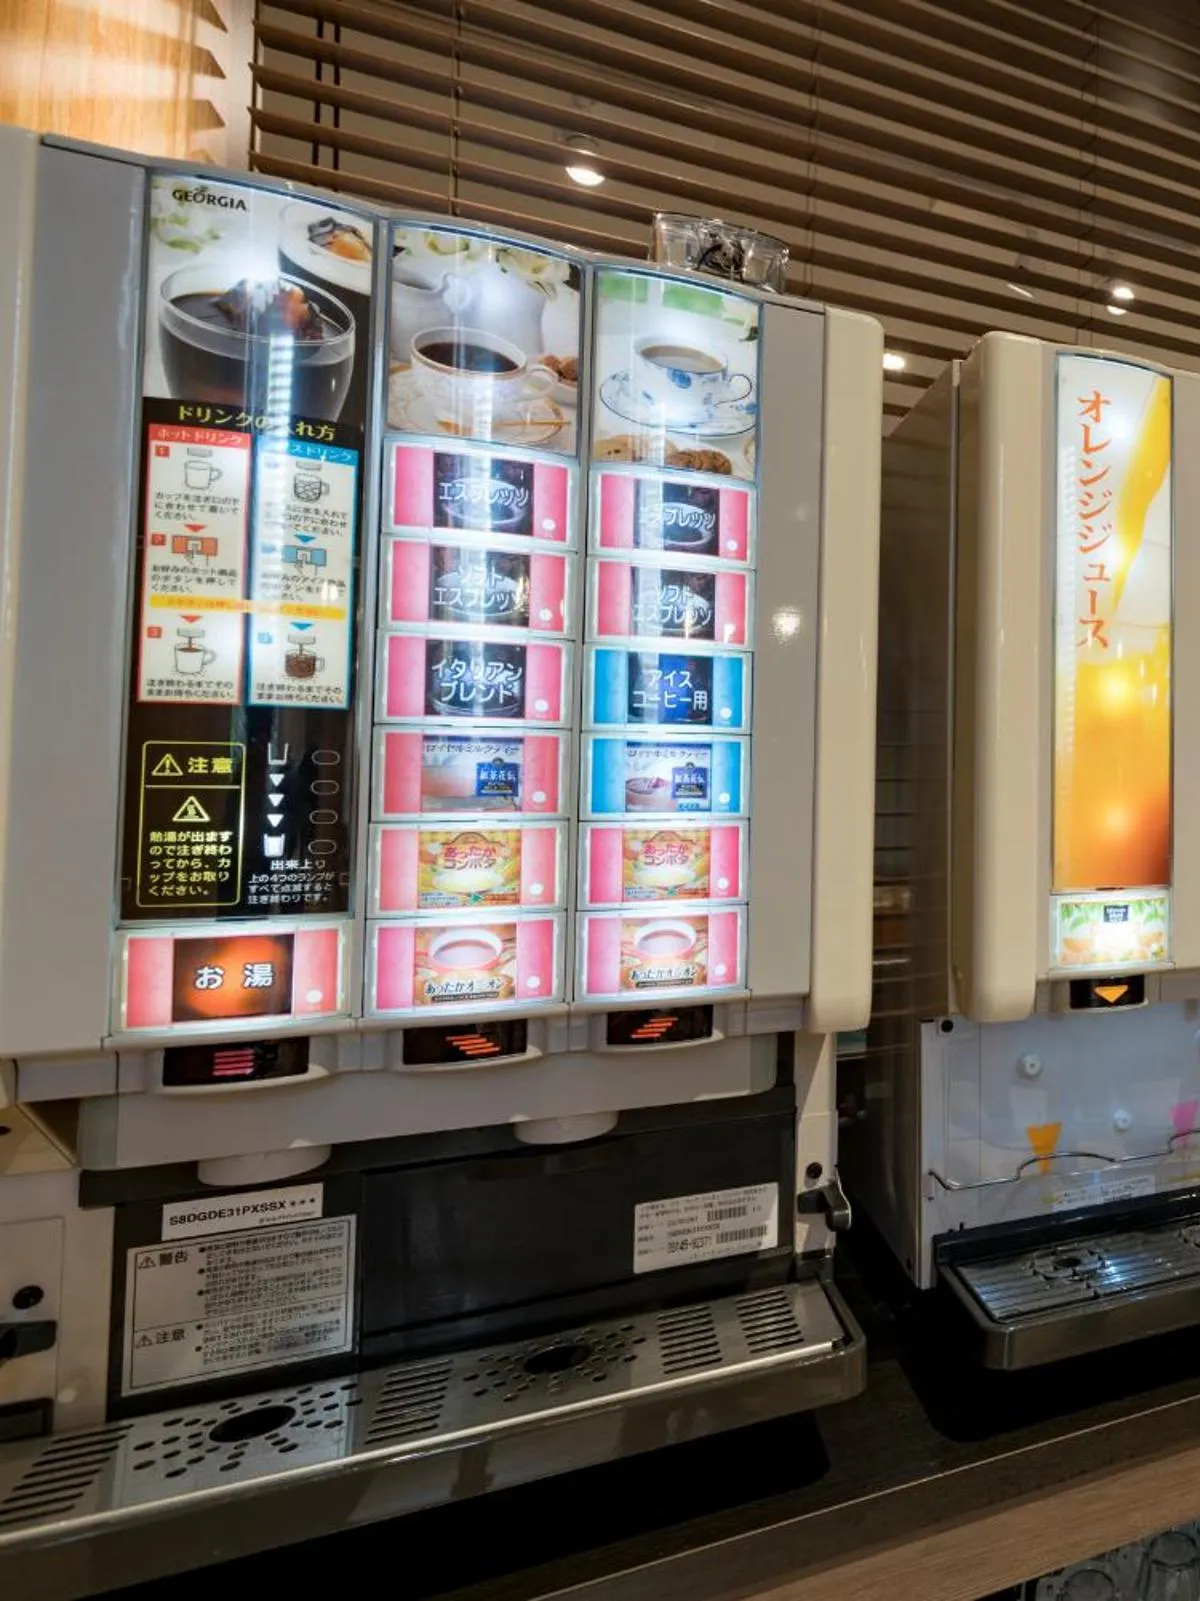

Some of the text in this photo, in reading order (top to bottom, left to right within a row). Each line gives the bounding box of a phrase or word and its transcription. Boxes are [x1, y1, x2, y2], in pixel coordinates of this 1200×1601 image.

[172, 186, 247, 211] GEORGIA
[178, 405, 337, 442] ドリンクのれ方
[1076, 389, 1113, 650] オレンジジュース
[431, 660, 523, 683] イタリアン
[646, 668, 693, 689] アイス
[440, 681, 515, 703] ブレンド
[632, 690, 708, 712] コーヒー用
[187, 756, 233, 775] 注意
[149, 831, 233, 844] 熱湯が出ます
[149, 844, 233, 857] ので注ぎ終わ
[150, 858, 232, 870] ってから、カ
[270, 859, 326, 871] 出来上り
[150, 871, 230, 883] ップをお取り
[149, 884, 211, 897] ください。
[195, 963, 273, 990] お湯
[156, 1328, 185, 1345] 注意
